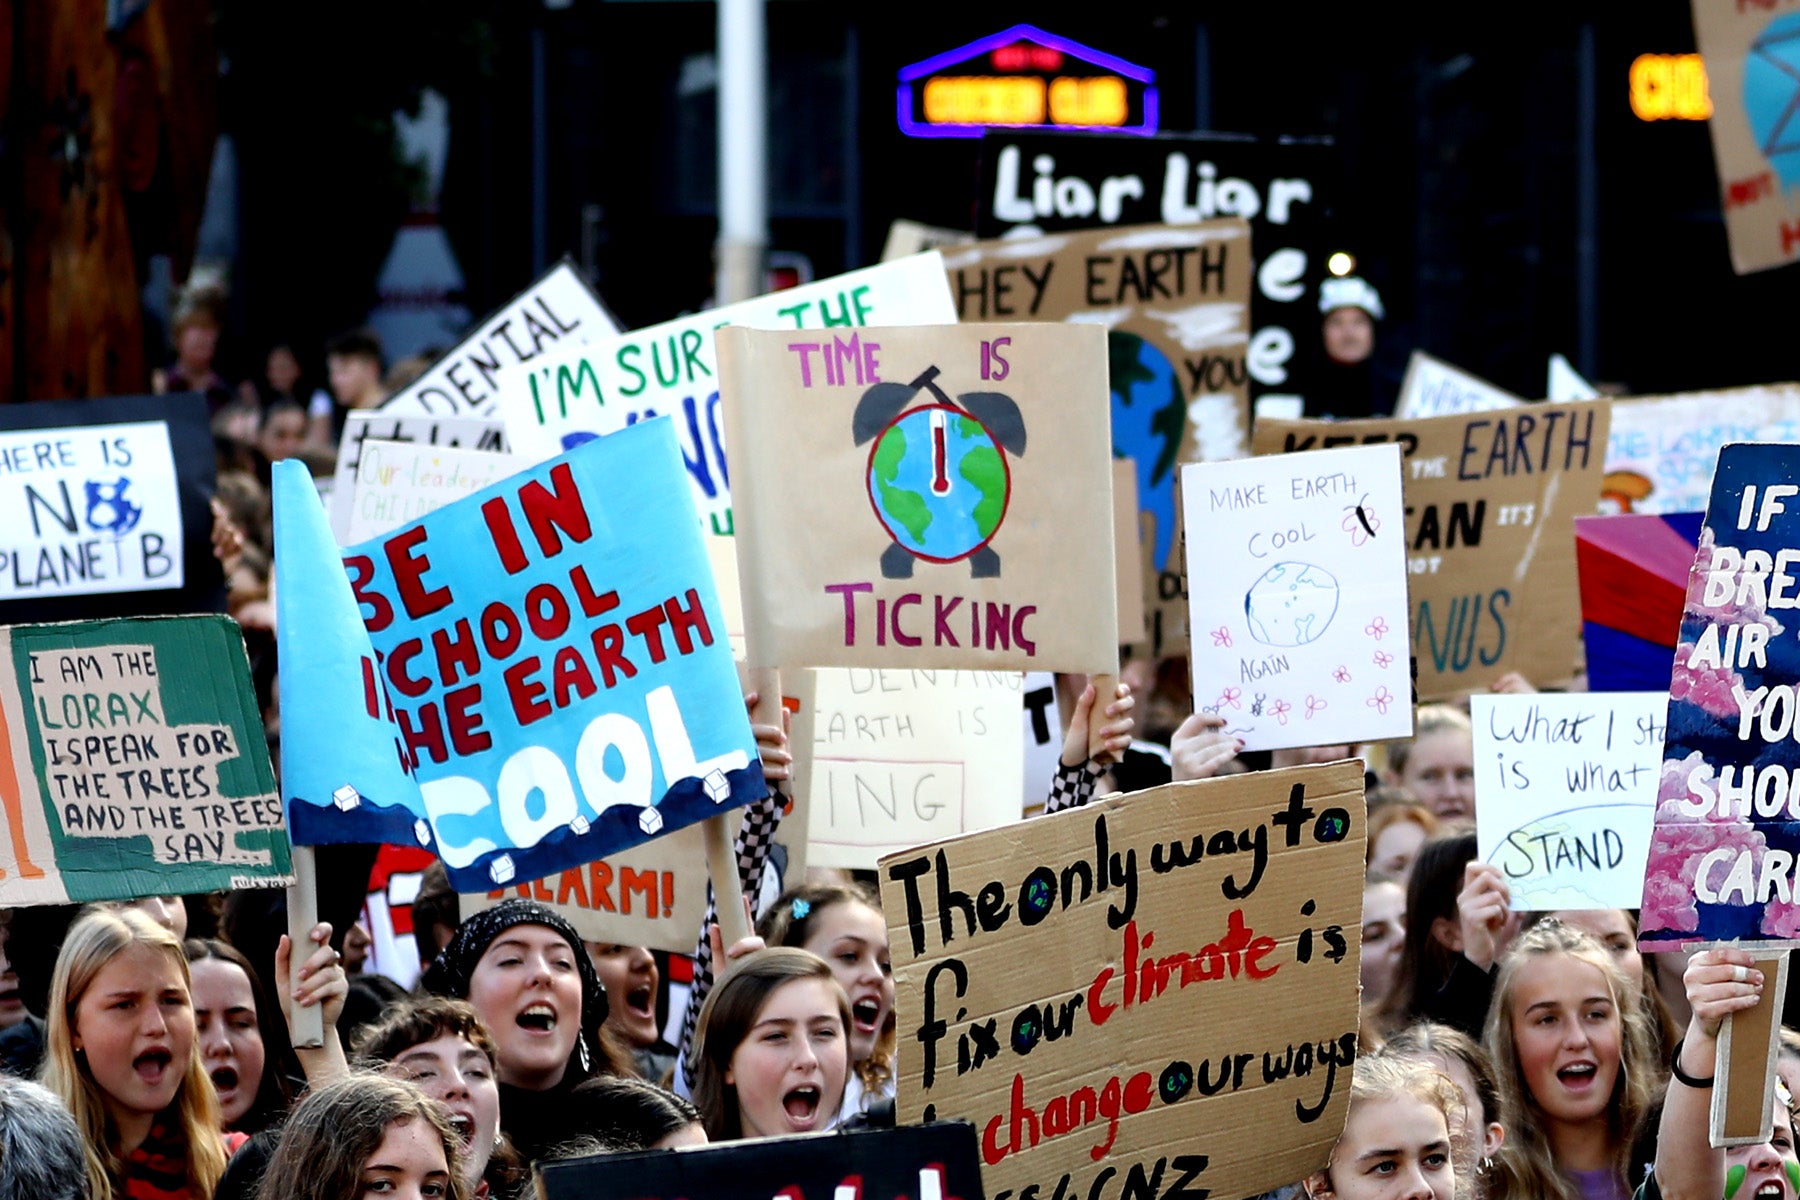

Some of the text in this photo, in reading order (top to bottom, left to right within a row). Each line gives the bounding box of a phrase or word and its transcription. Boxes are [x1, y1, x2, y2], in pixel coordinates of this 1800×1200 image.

[994, 144, 1311, 225] Liar Liar
[957, 245, 1228, 319] HEY EARTH
[529, 358, 605, 425] I'M
[616, 322, 731, 398] SUR
[788, 332, 1011, 388] TIME IS
[100, 438, 133, 467] IS
[1411, 457, 1448, 480] THE
[1458, 410, 1595, 481] EARTH
[1210, 473, 1357, 511] MAKE EARTH
[1738, 485, 1798, 531] IF
[141, 533, 173, 579] B
[343, 462, 592, 632] BE IN
[1249, 523, 1316, 558] COOL
[375, 565, 619, 697] CHOOL
[824, 582, 1037, 657] TICKING
[29, 652, 157, 683] I AM THE
[504, 589, 714, 726] EARTH
[1688, 623, 1769, 670] AIR
[40, 692, 160, 730] LORAX
[957, 706, 988, 736] IS
[1490, 704, 1614, 750] What I
[177, 729, 233, 757] FOR
[54, 765, 211, 799] THE TREES
[422, 685, 750, 869] COOL
[1497, 752, 1652, 793] is what
[65, 800, 284, 831] AND THE TREES
[890, 782, 1351, 957] The only way to
[1503, 829, 1624, 878] STAND
[917, 899, 1348, 1089] fix our climate is
[982, 1032, 1357, 1164] change our ways
